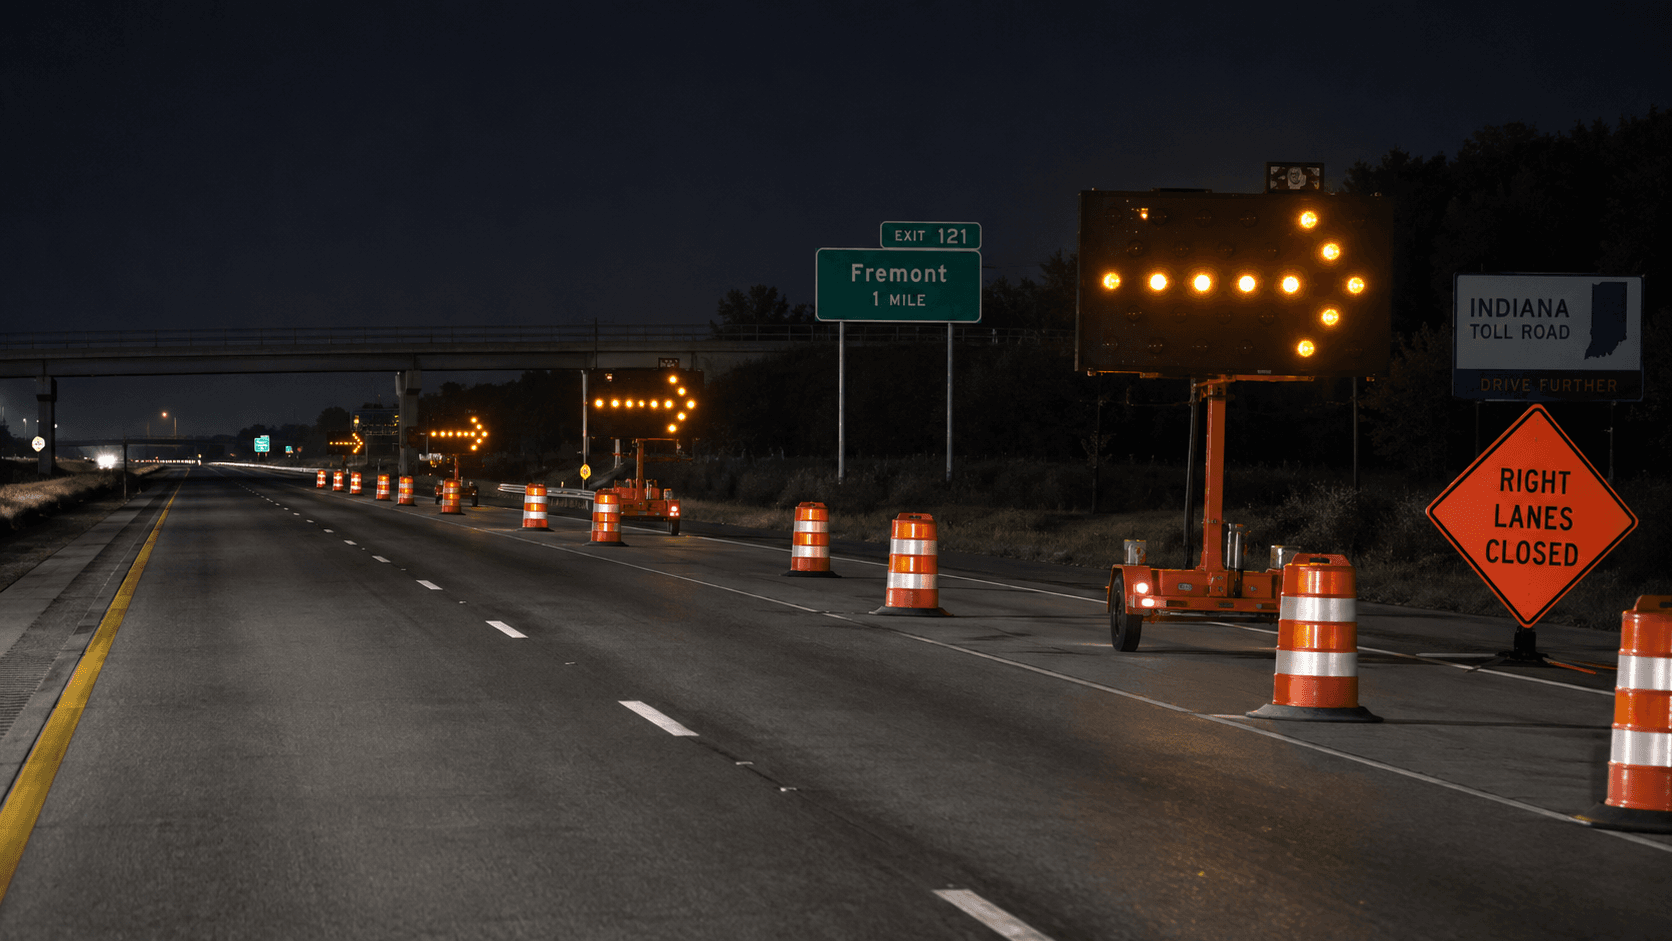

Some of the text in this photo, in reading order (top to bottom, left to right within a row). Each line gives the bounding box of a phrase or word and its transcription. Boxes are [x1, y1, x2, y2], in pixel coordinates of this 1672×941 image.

[895, 228, 967, 244] EXIT 121
[851, 263, 947, 283] Fremont
[872, 291, 926, 306] 1 MILE
[1470, 298, 1570, 318] INDIANA
[1470, 323, 1570, 340] TOLL ROAD
[1480, 378, 1618, 393] DRIVE FURTHER
[1499, 467, 1571, 495] RIGHT
[1494, 503, 1573, 531] LANES
[1485, 538, 1579, 567] CLOSED
